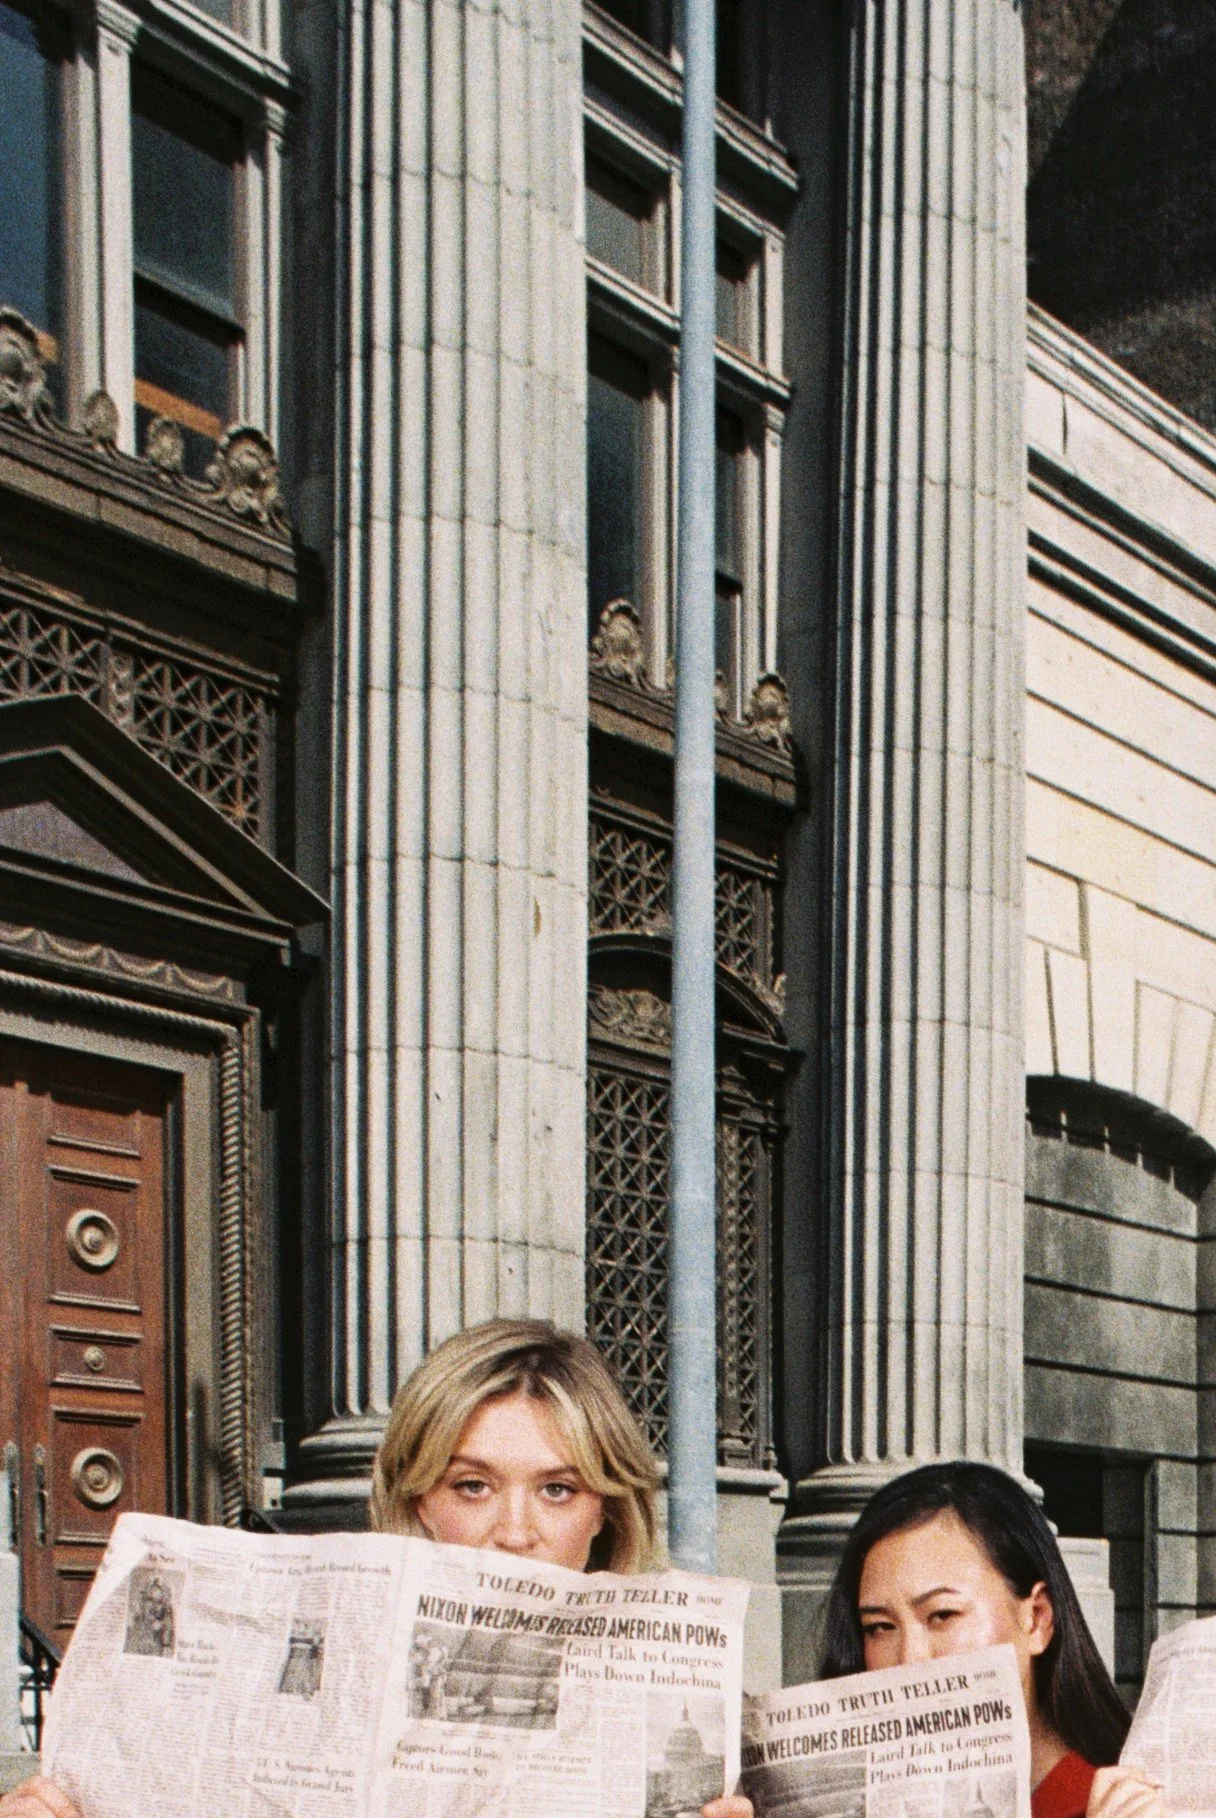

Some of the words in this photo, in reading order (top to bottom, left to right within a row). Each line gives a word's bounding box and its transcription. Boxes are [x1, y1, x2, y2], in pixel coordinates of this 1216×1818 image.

[476, 1572, 556, 1601] TOLEDO
[565, 1589, 616, 1606] TRUTH
[622, 1588, 689, 1607] TELLER
[417, 1594, 468, 1625] NIXON
[607, 1618, 681, 1645] AMERICAN
[686, 1623, 727, 1649] POWs
[566, 1640, 602, 1659] Laird
[608, 1645, 636, 1662] Talk
[642, 1649, 658, 1663] to
[662, 1649, 724, 1671] Congress
[564, 1662, 600, 1682] Plays
[604, 1664, 644, 1684] Down
[650, 1666, 721, 1690] Indochina
[766, 1701, 831, 1727] TOLEDO
[837, 1688, 895, 1713] TRUTH
[900, 1675, 970, 1702] TELLER
[766, 1729, 838, 1761] WELCOMES
[841, 1719, 902, 1750] RELEASED
[905, 1704, 972, 1737] AMERICAN
[974, 1698, 1013, 1727] POWs
[870, 1747, 905, 1765] Laird
[909, 1742, 936, 1759] Talk
[940, 1741, 953, 1754] to
[956, 1732, 1013, 1752] Congress
[870, 1768, 902, 1785] Plays
[905, 1761, 943, 1778] Down
[948, 1753, 1013, 1774] Indochina
